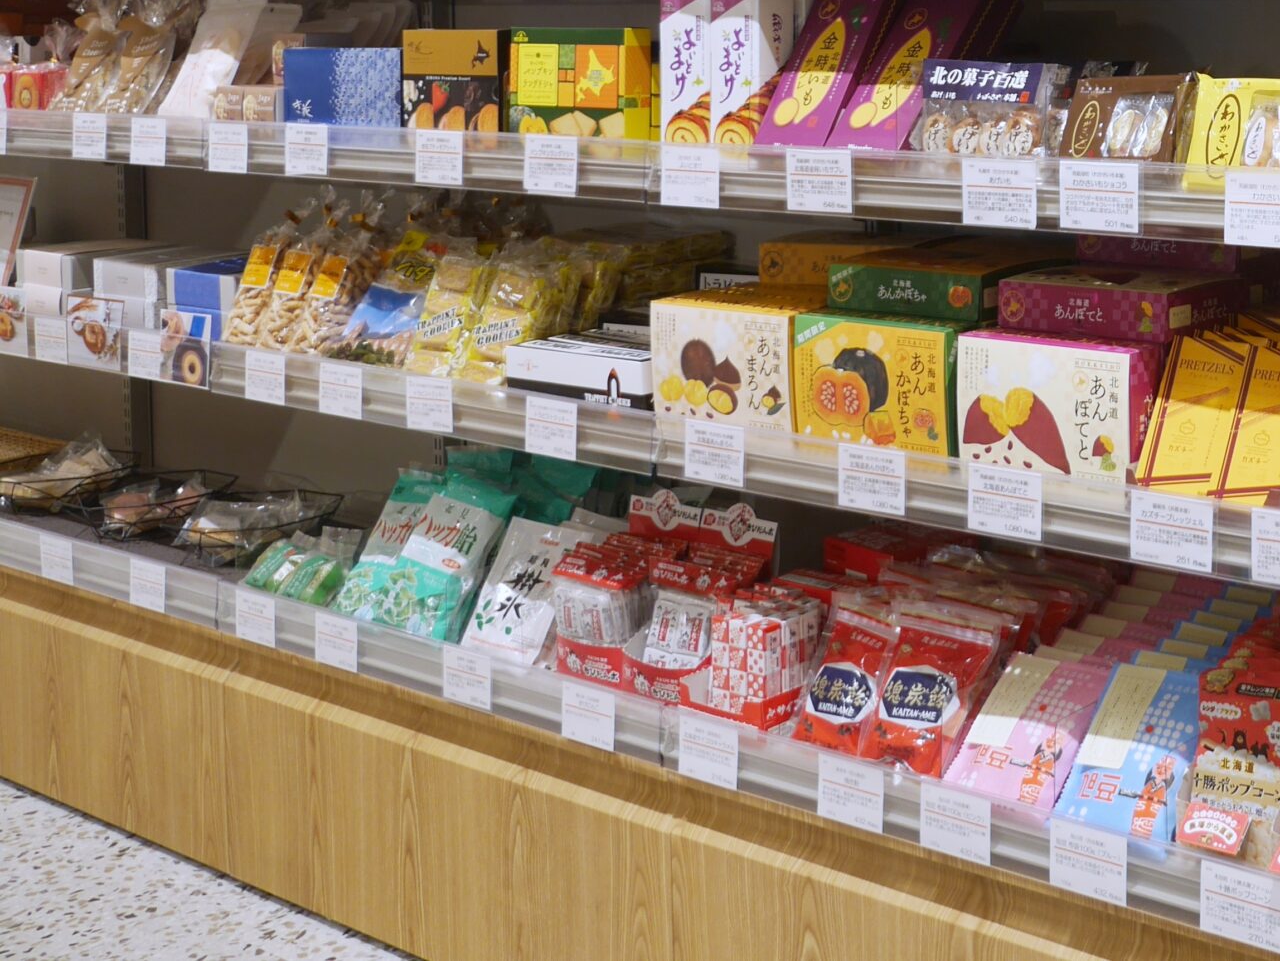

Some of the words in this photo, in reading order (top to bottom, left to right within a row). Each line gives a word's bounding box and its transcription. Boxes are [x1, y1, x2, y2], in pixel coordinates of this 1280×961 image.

[929, 65, 1030, 90] 北の菓子百選
[1072, 180, 1128, 190] わかさいもショコラ
[877, 286, 928, 303] あんかぼちゃ
[1068, 297, 1090, 307] 北海道
[1054, 305, 1103, 323] あんぽてと
[910, 352, 927, 397] あん
[927, 353, 936, 394] 北海道
[1179, 358, 1236, 376] PRETZELS
[747, 356, 760, 411] まろん
[896, 371, 912, 439] かぼちゃ
[1089, 375, 1108, 422] あん
[1108, 375, 1119, 421] 北海道
[1074, 399, 1090, 462] ぽてと
[1141, 511, 1204, 527] カズチープレッツェル
[817, 701, 855, 718] KAITAN-AME
[891, 705, 938, 722] KAITAN-AME
[1220, 757, 1256, 775] 北海道
